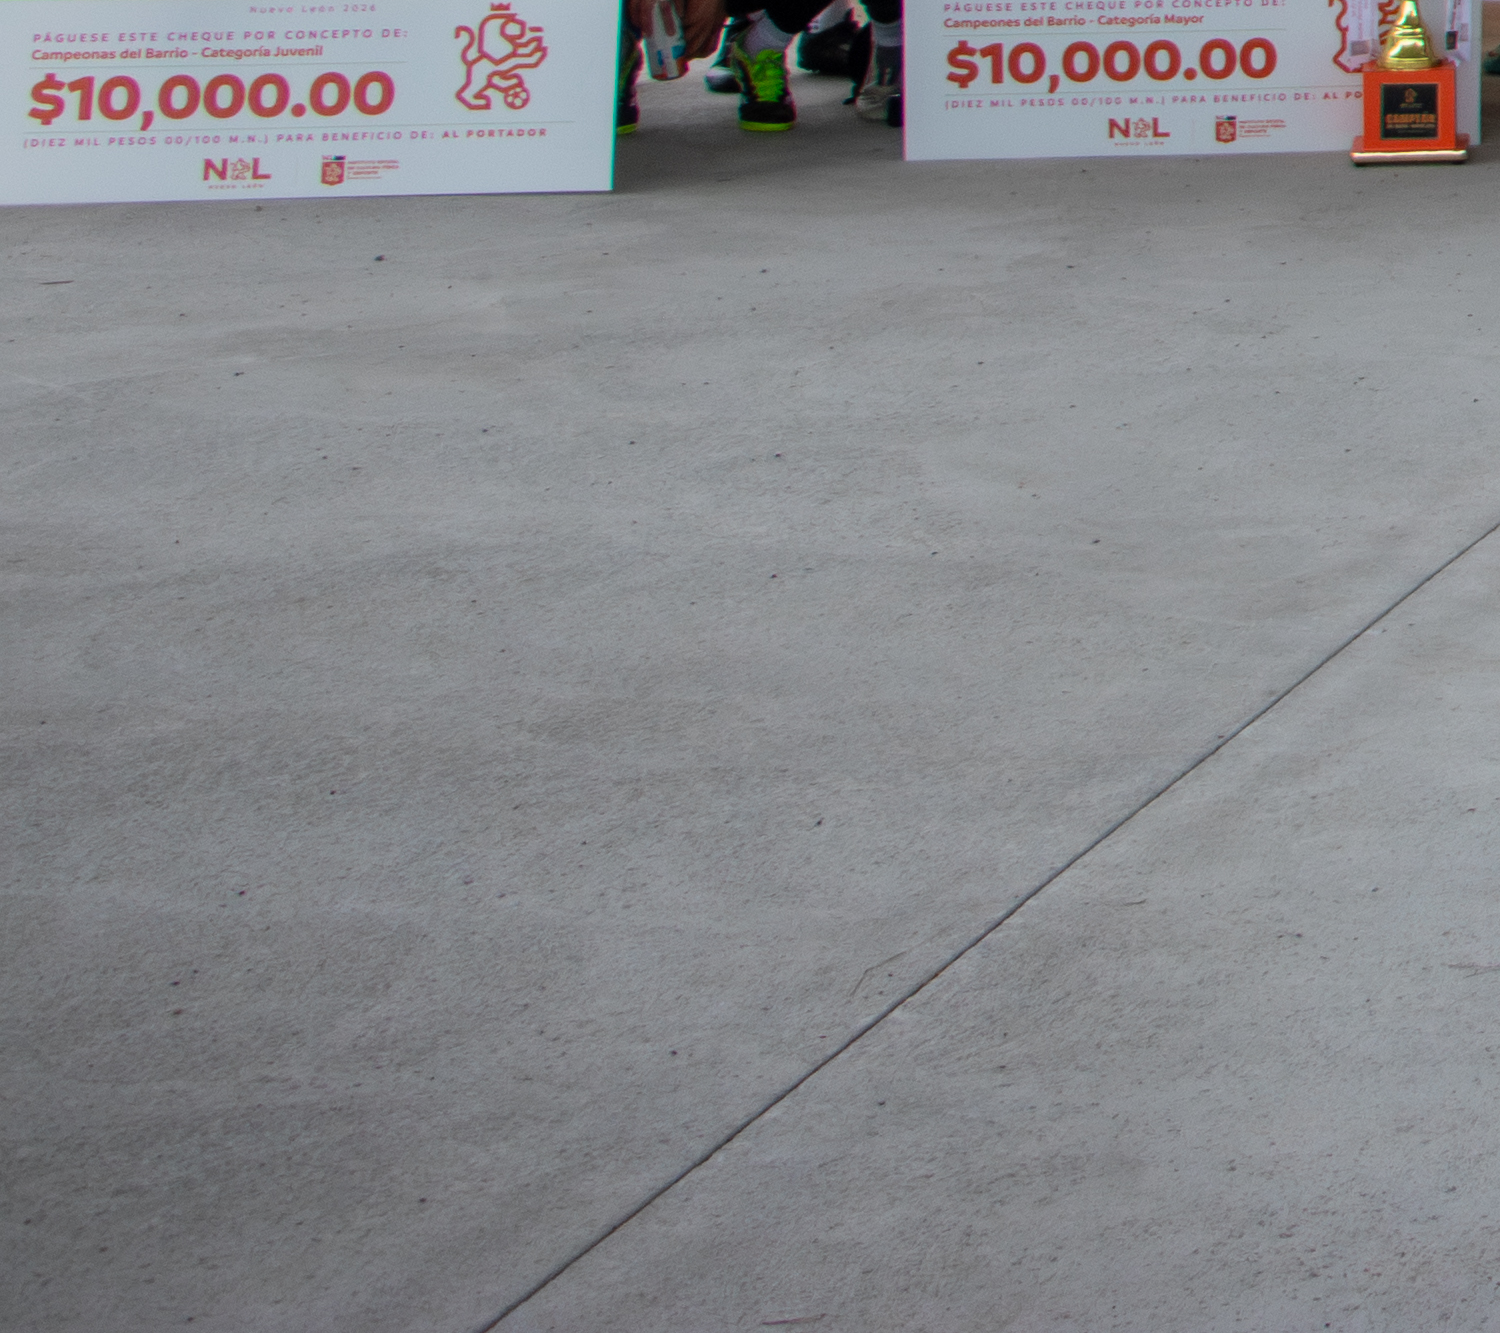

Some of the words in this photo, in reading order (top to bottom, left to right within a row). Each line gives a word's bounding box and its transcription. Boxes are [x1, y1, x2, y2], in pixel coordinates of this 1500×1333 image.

[944, 16, 1021, 29] Campeones
[1024, 16, 1044, 27] del
[1047, 15, 1086, 26] Barrio
[1097, 13, 1161, 27] Categoría
[1164, 14, 1204, 27] Mayor
[33, 31, 109, 44] PÁGUESE
[118, 31, 158, 42] ESTE
[167, 30, 235, 43] CHEQUE
[244, 30, 276, 41] POR
[285, 28, 373, 40] CONCEPTO
[381, 28, 408, 39] DE:
[31, 49, 116, 62] Campeonas
[120, 48, 142, 59] del
[146, 47, 188, 59] Barrio
[201, 46, 271, 61] Categoría
[274, 45, 323, 58] Juvenil
[946, 37, 1277, 94] $10,000.00
[27, 70, 396, 132] $10,000.00
